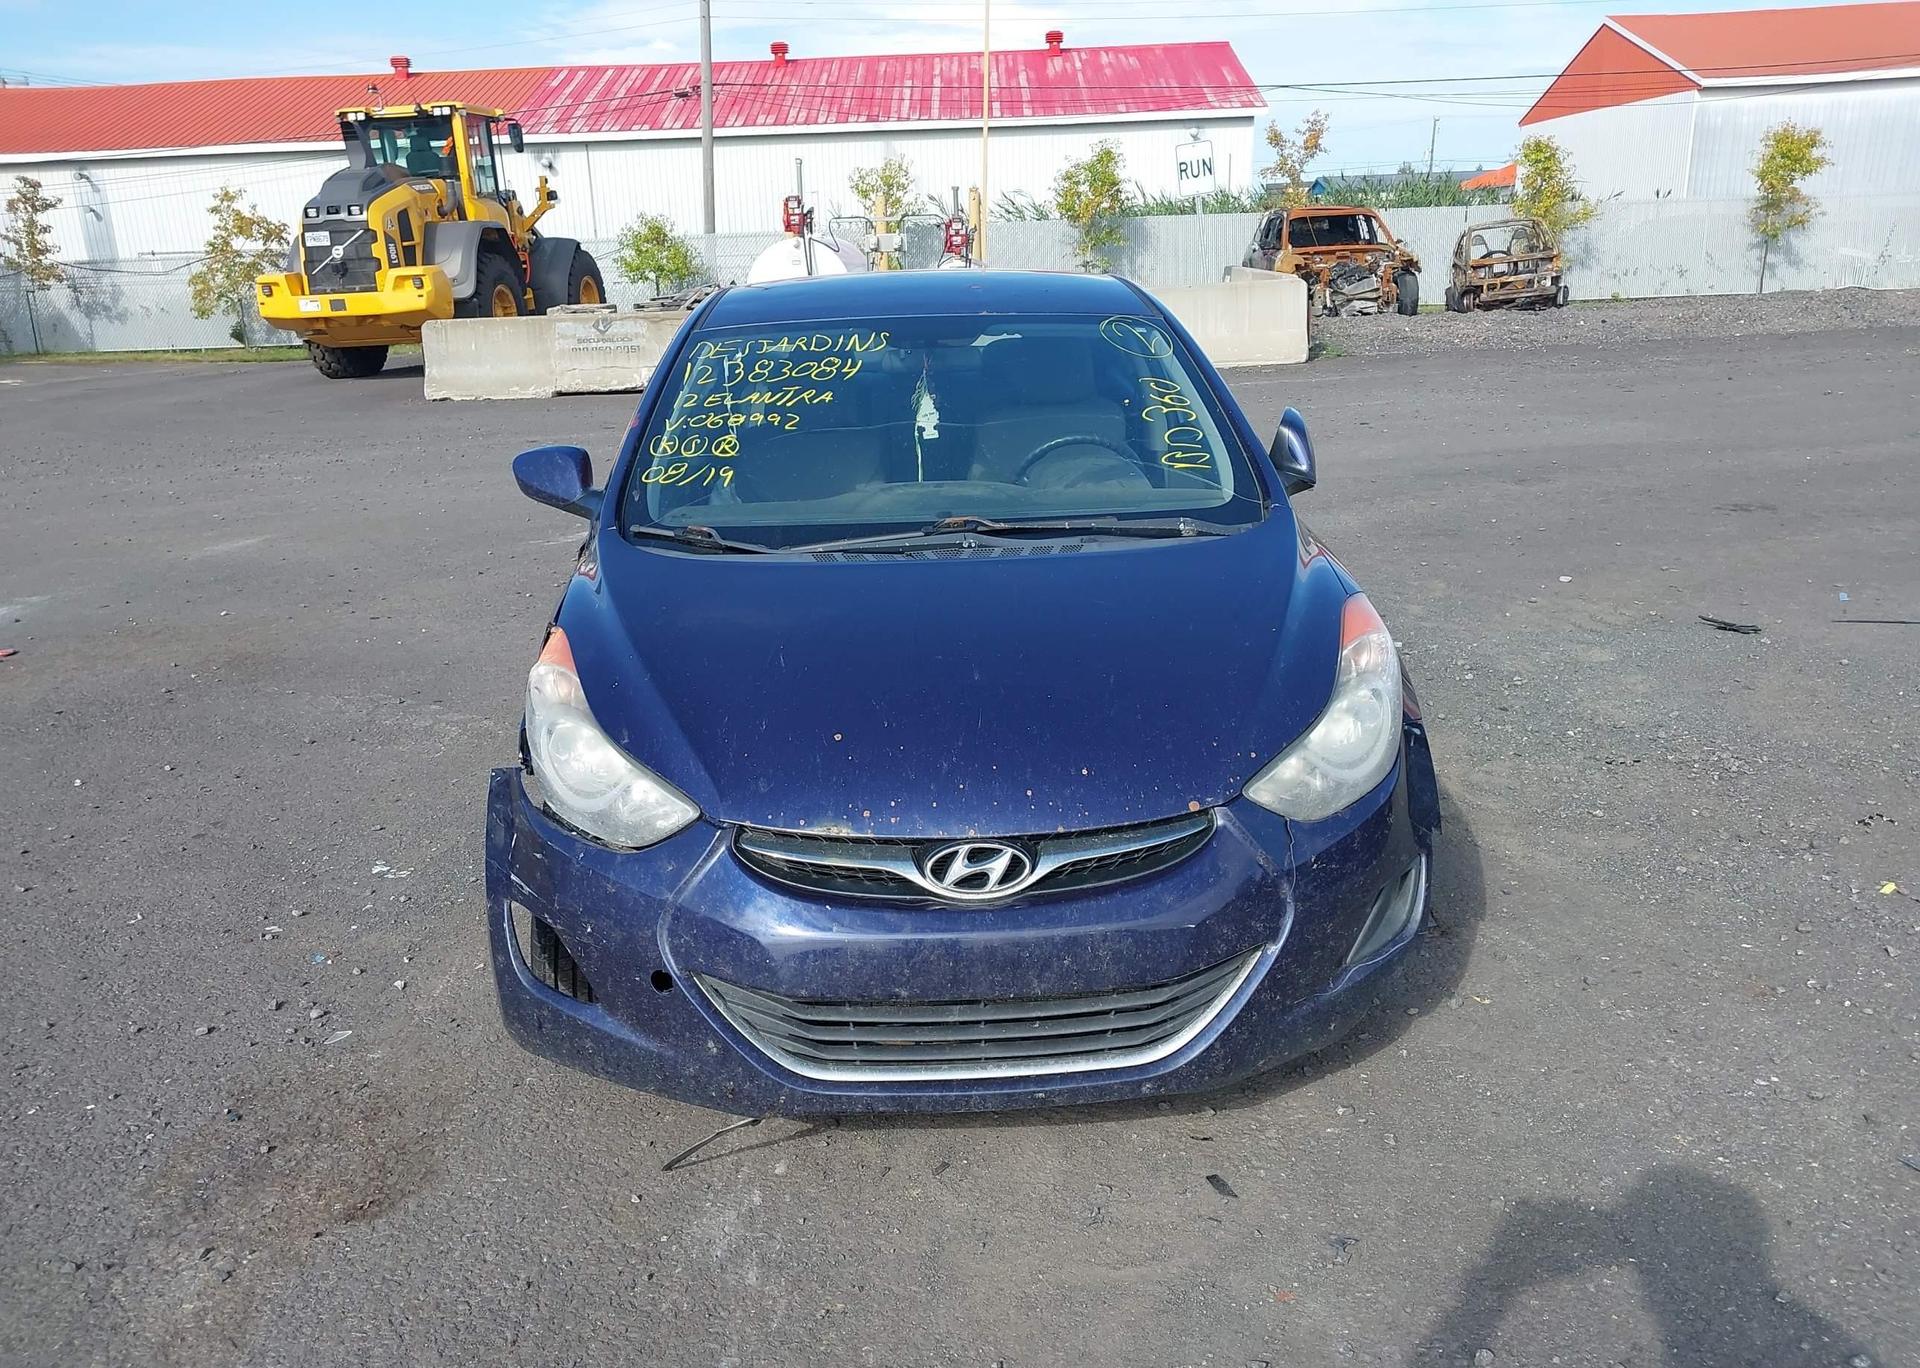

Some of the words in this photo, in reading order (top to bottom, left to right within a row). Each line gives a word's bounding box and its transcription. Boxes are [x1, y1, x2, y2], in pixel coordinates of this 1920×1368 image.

[1179, 157, 1212, 180] RUN
[388, 243, 399, 264] L90H
[688, 332, 890, 359] DESJARDINS
[704, 386, 834, 409] ELANTRA
[641, 462, 734, 487] 08/19
